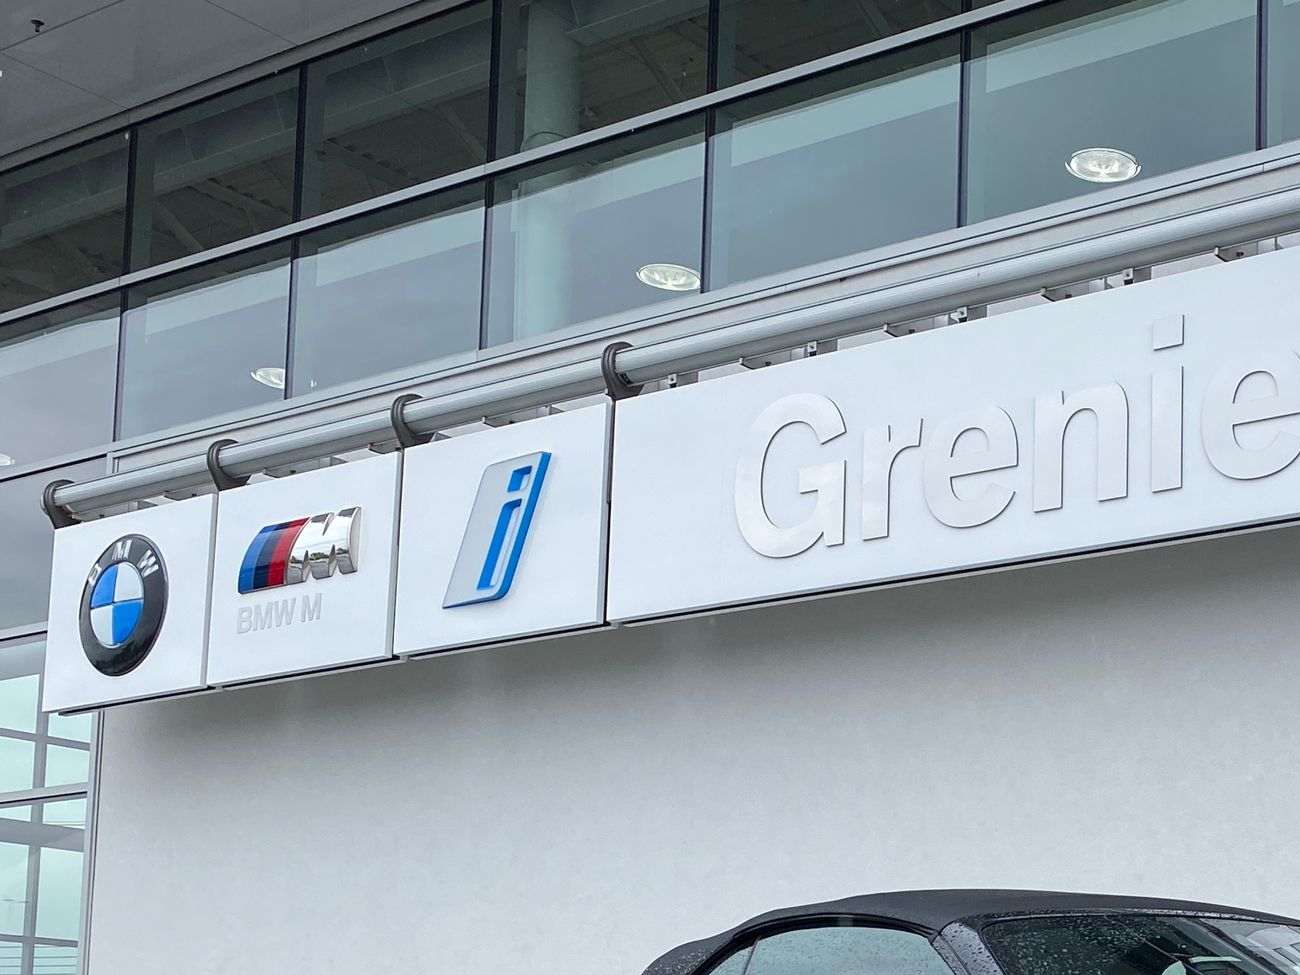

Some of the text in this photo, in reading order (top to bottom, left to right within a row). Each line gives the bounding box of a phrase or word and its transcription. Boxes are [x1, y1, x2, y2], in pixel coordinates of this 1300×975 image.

[87, 539, 160, 587] BMW
[237, 592, 323, 634] BMW M
